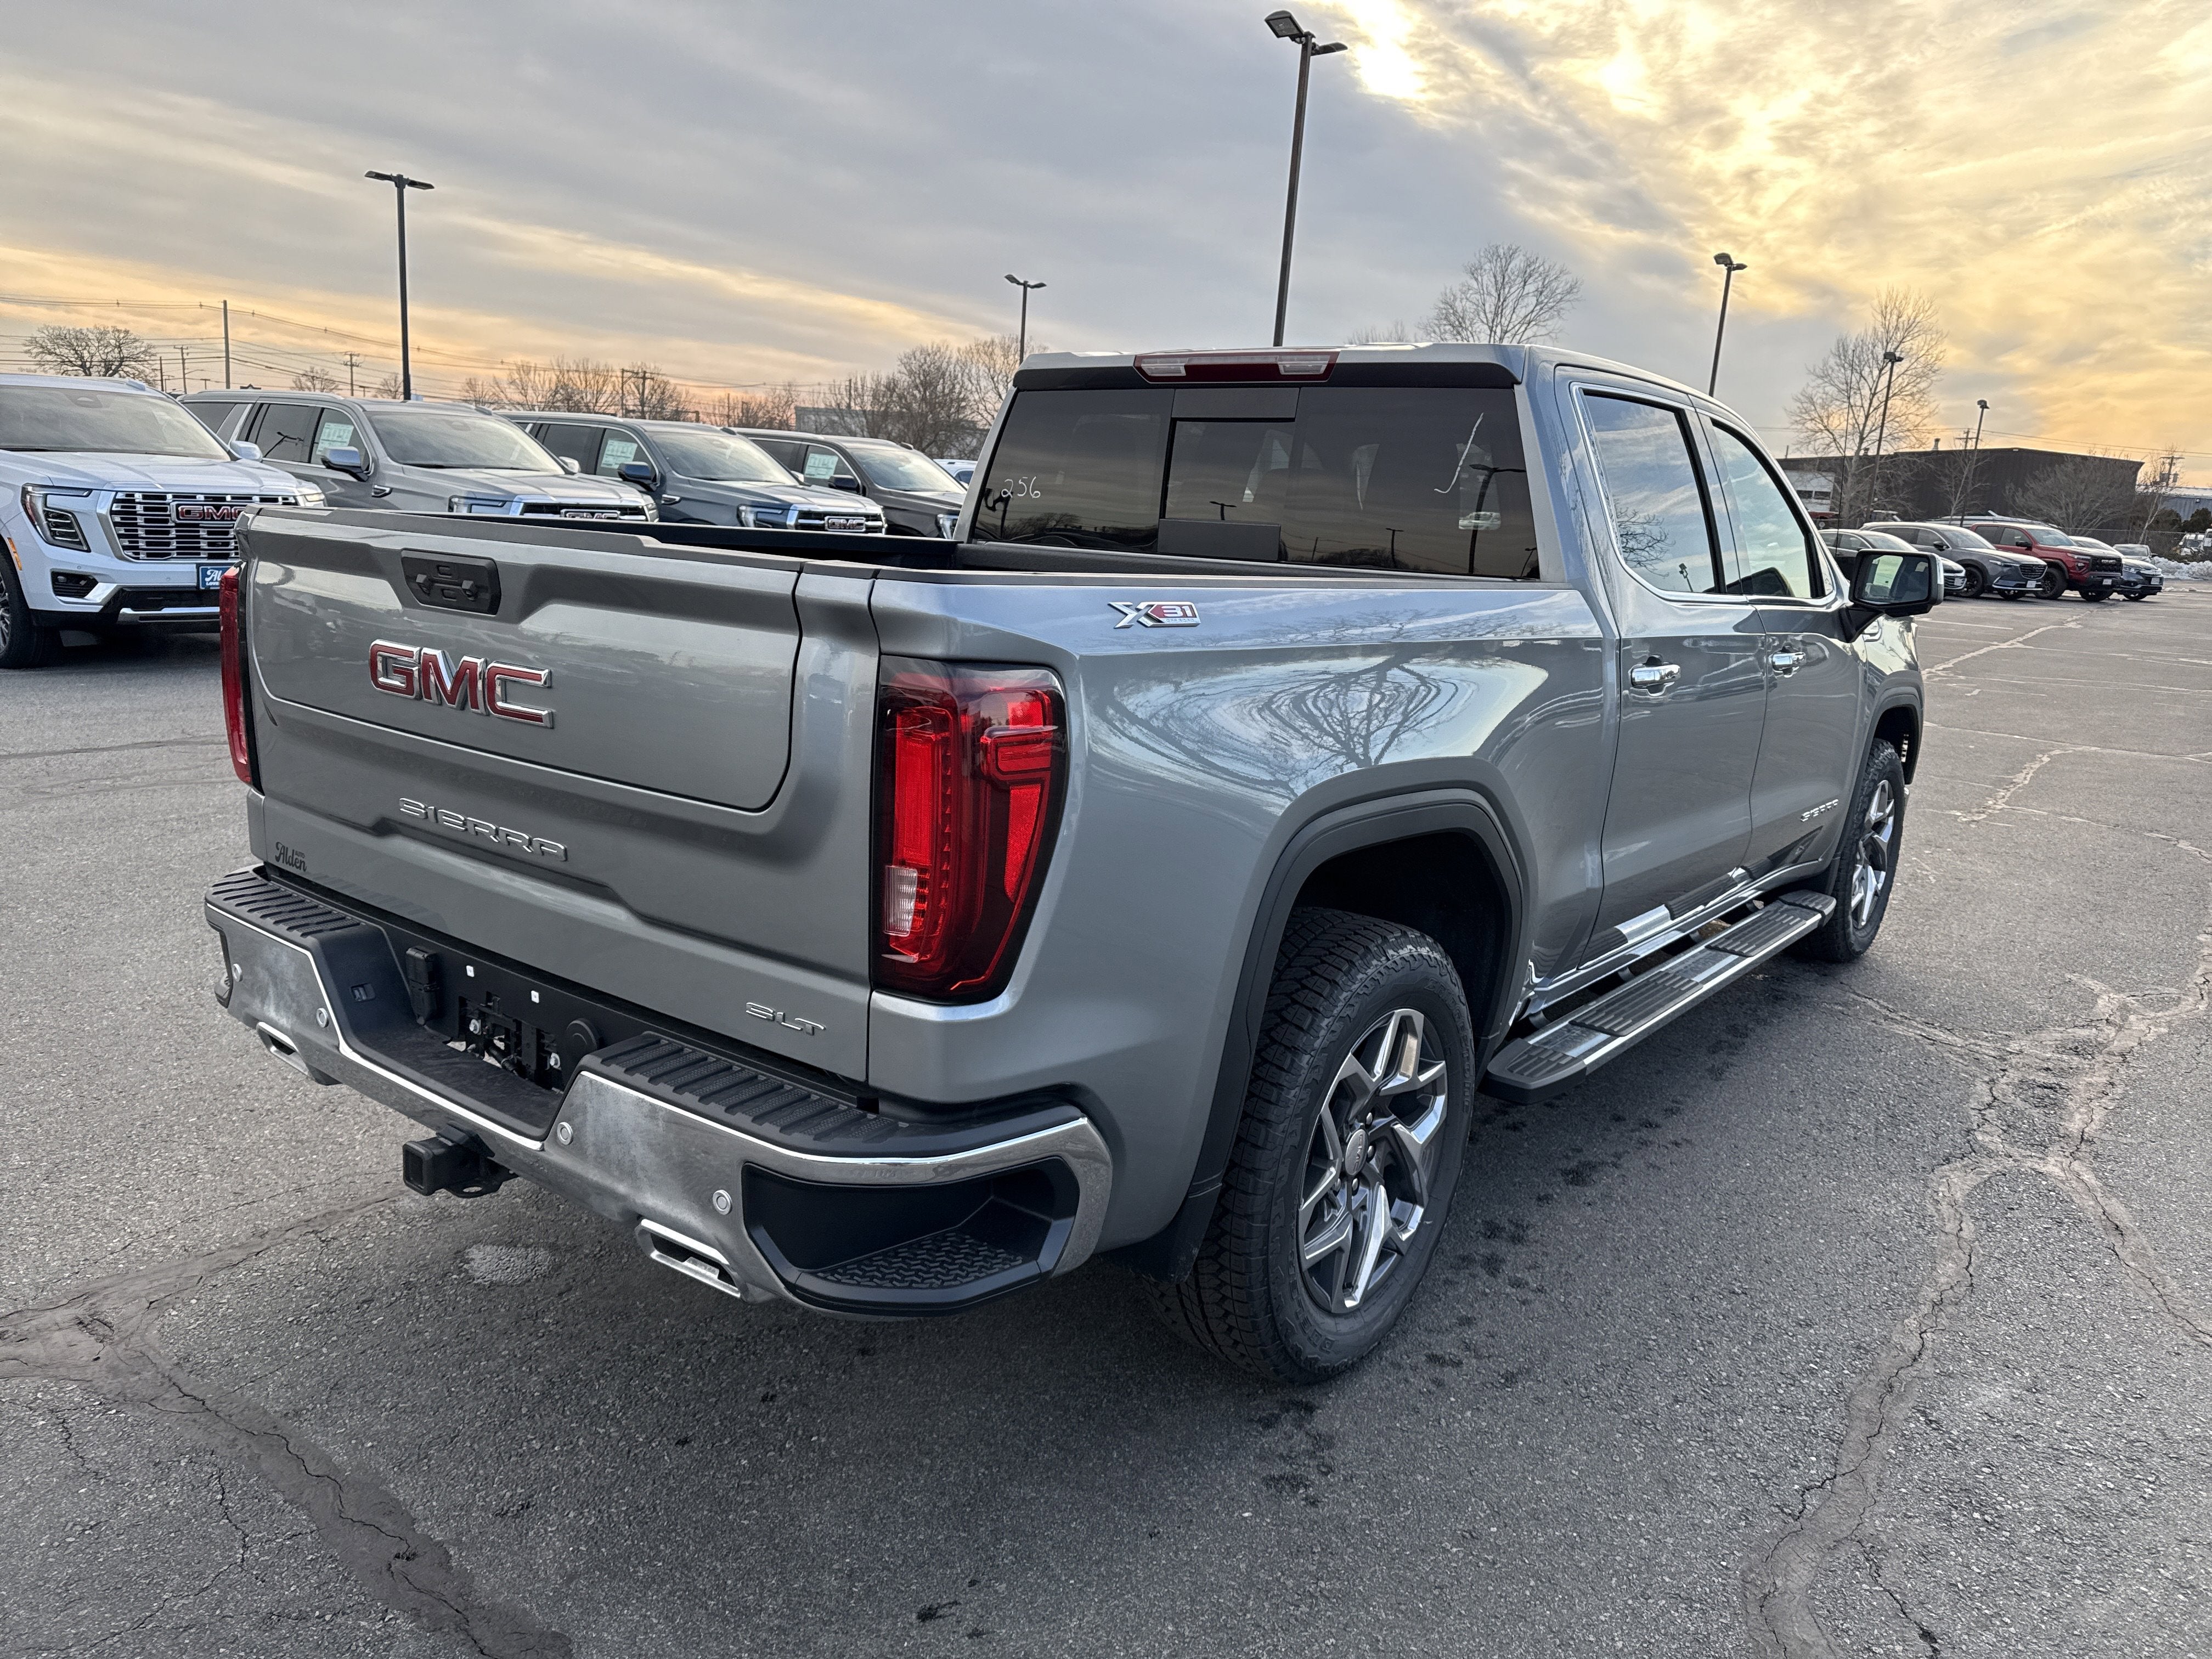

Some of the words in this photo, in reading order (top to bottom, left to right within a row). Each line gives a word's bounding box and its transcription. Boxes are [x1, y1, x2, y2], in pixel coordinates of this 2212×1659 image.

[1001, 476, 1041, 499] 256
[828, 518, 865, 529] GMC
[1107, 602, 1196, 629] X31
[369, 639, 554, 729] GMC
[399, 798, 568, 861] SIERRA
[275, 842, 307, 872] Alden
[746, 1002, 826, 1036] SLT
[1353, 1133, 1363, 1172] GMC
